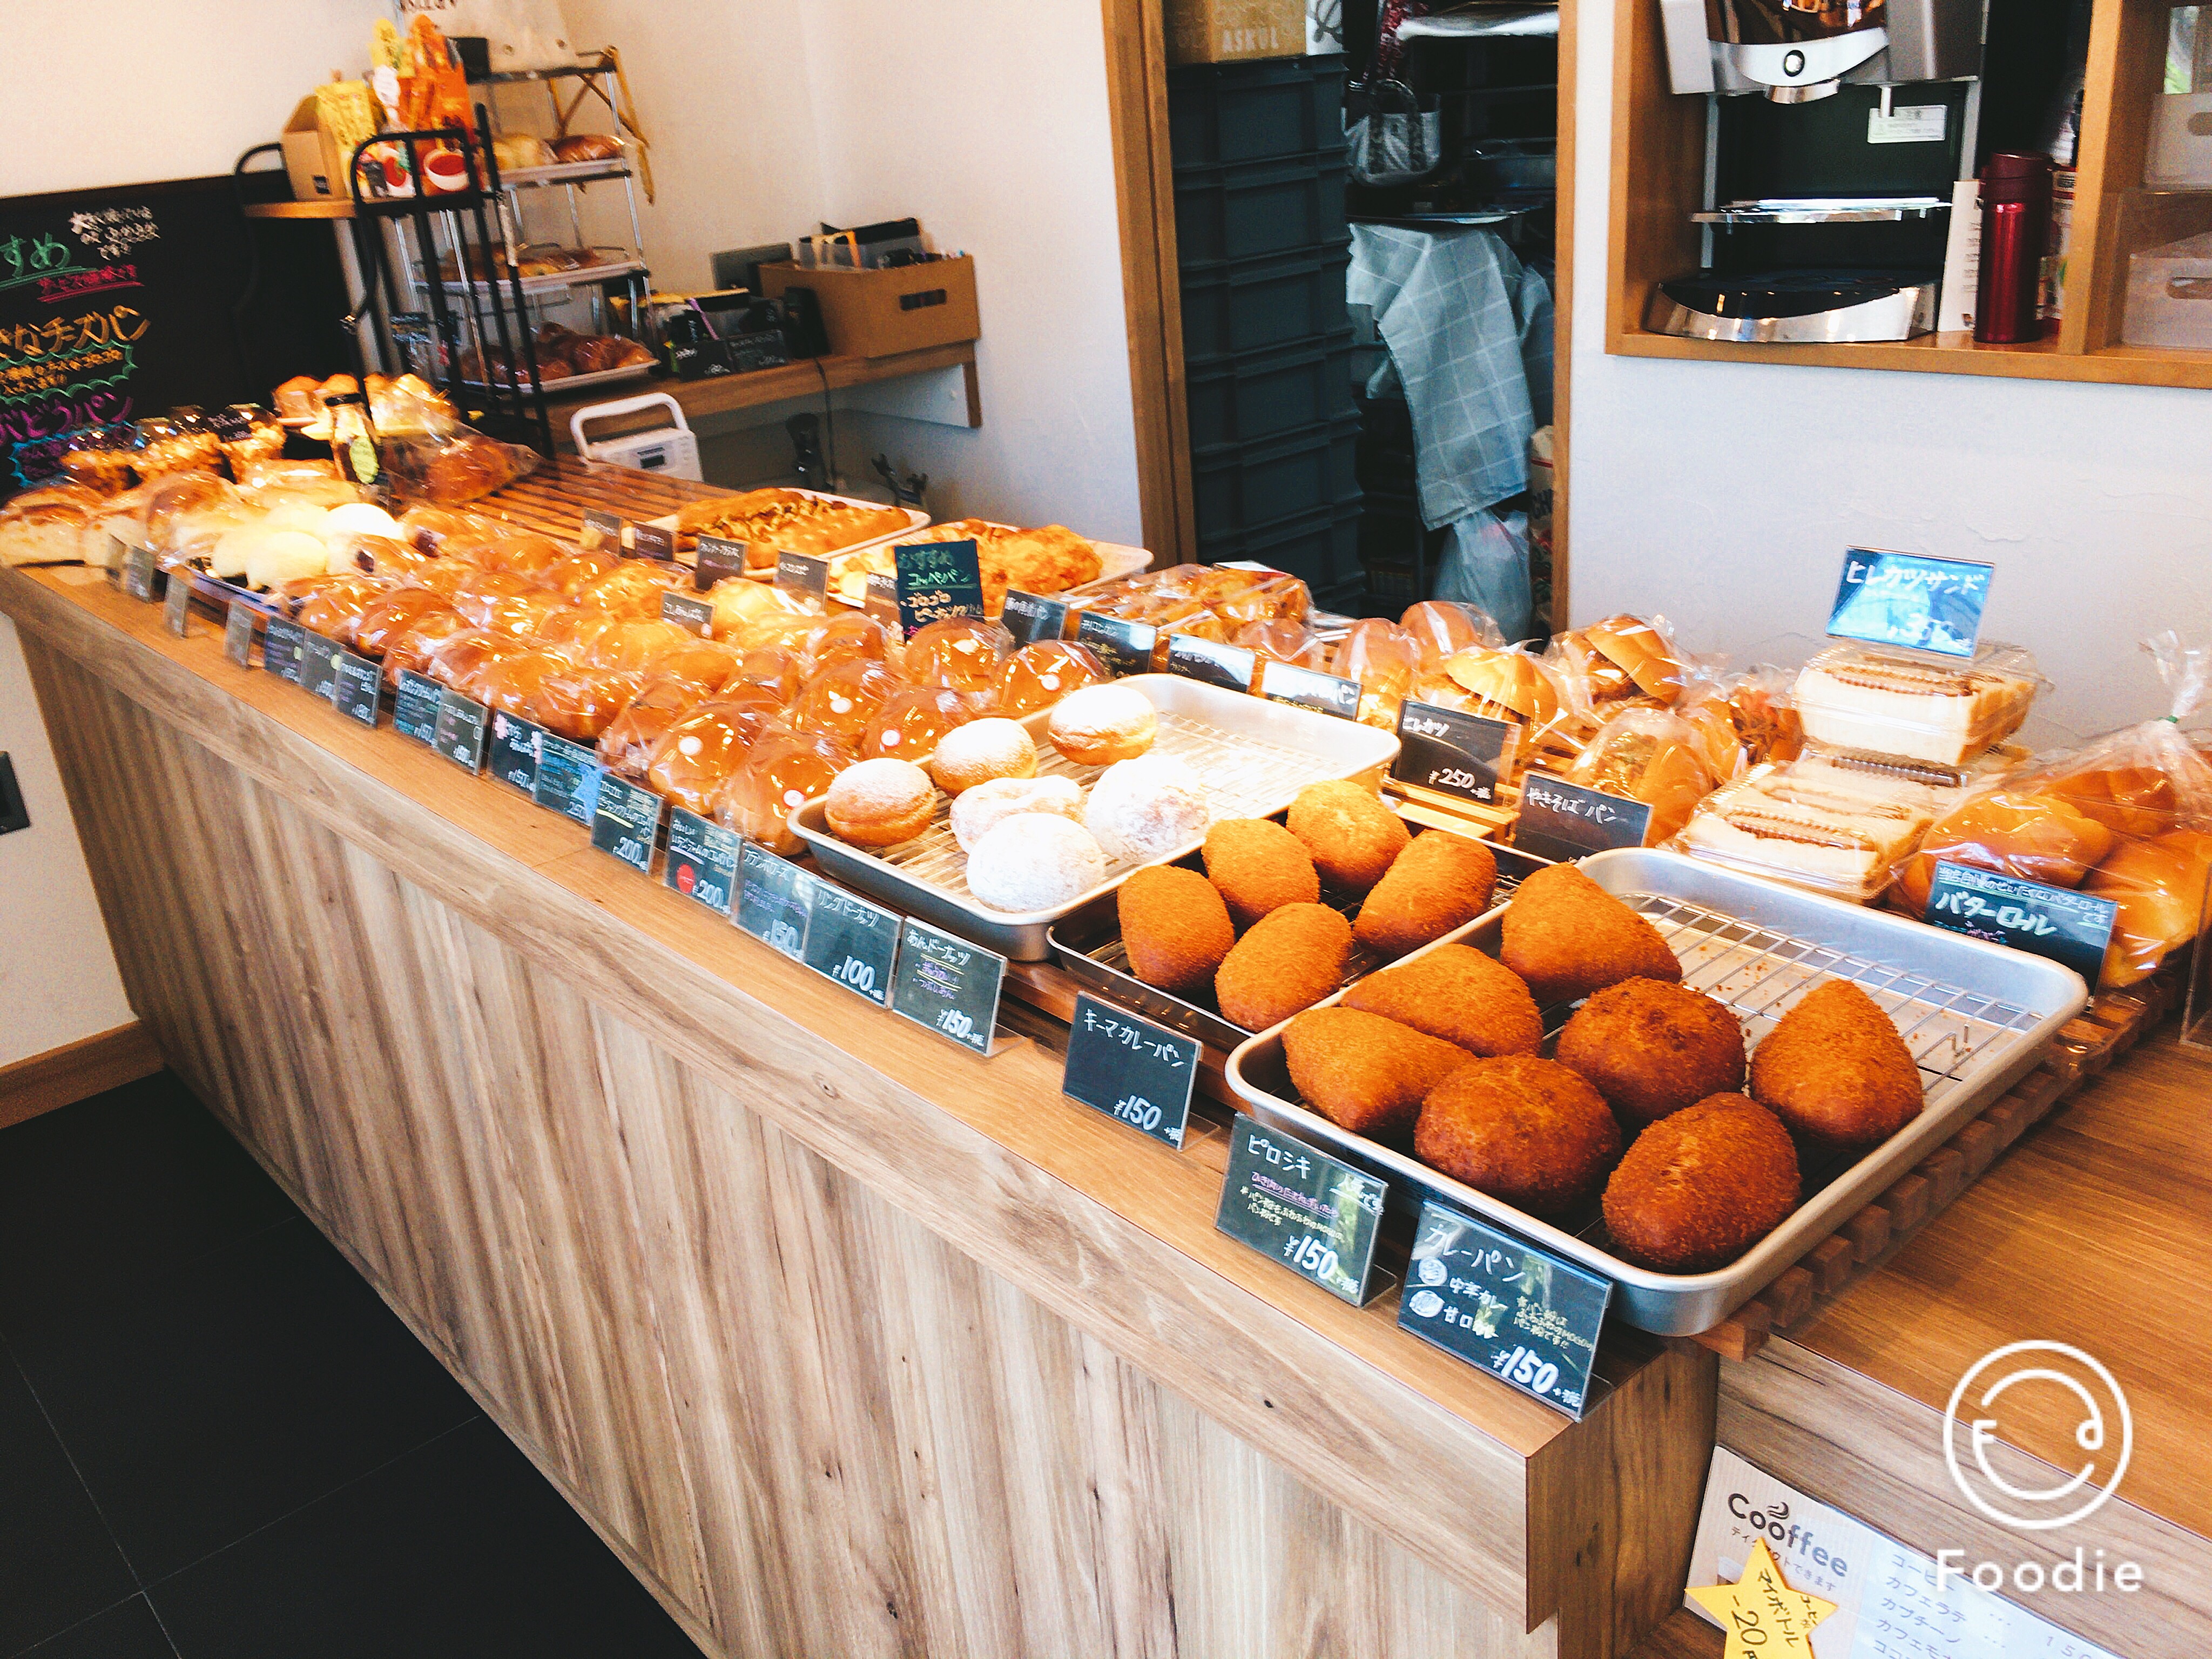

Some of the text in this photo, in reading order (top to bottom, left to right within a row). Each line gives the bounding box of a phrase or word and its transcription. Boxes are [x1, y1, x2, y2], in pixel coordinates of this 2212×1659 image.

[1935, 891, 2058, 936] バターロール
[1084, 1008, 1185, 1067] キーマカレーパン
[1247, 1133, 1311, 1179] ピロシキ
[1424, 1223, 1526, 1283] カレーパン
[1757, 1568, 1799, 1648] マイボトル
[1881, 1597, 1960, 1643] カプチーノ
[1886, 1576, 1967, 1622] カフェラテ
